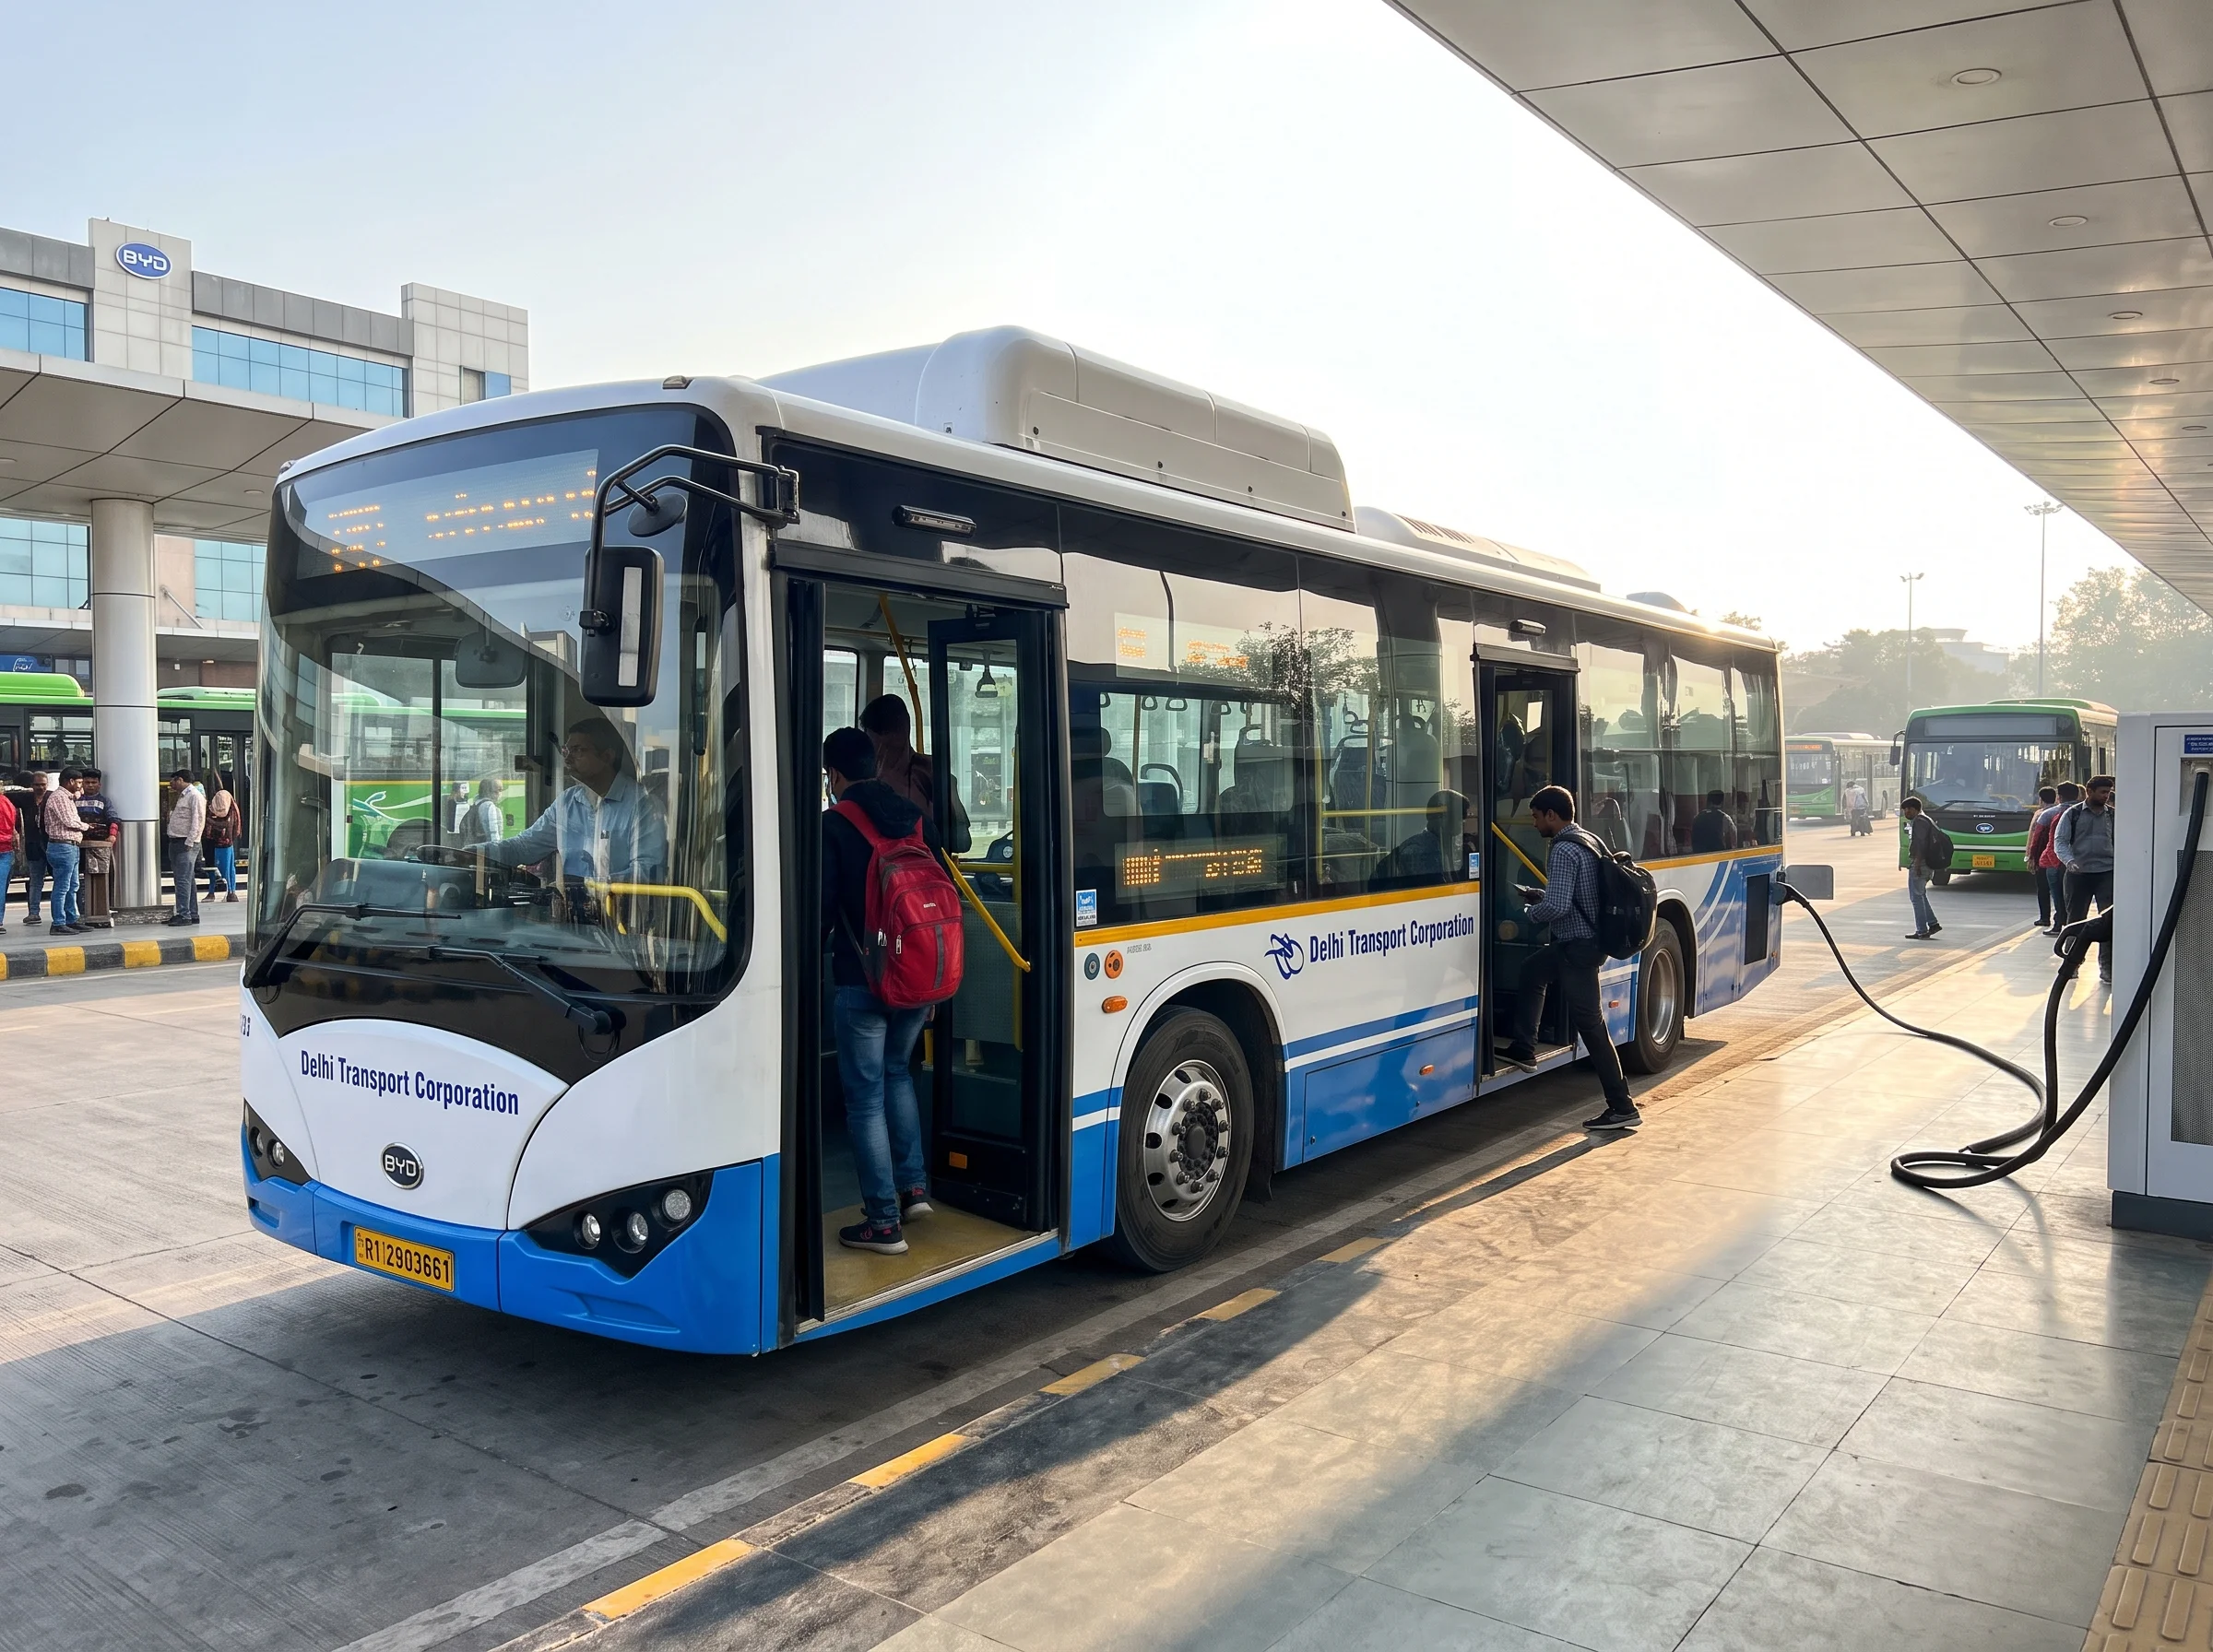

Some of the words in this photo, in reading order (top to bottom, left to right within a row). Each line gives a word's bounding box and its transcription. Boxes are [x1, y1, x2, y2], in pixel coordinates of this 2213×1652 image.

[123, 249, 167, 271] BYD
[1309, 931, 1344, 963] Delhi
[1348, 923, 1407, 957] Transport
[1410, 913, 1474, 949] Corporation
[301, 1049, 334, 1080] Delhi
[337, 1056, 410, 1097] Transport
[414, 1070, 519, 1115] Corporation
[385, 1154, 417, 1177] BYD
